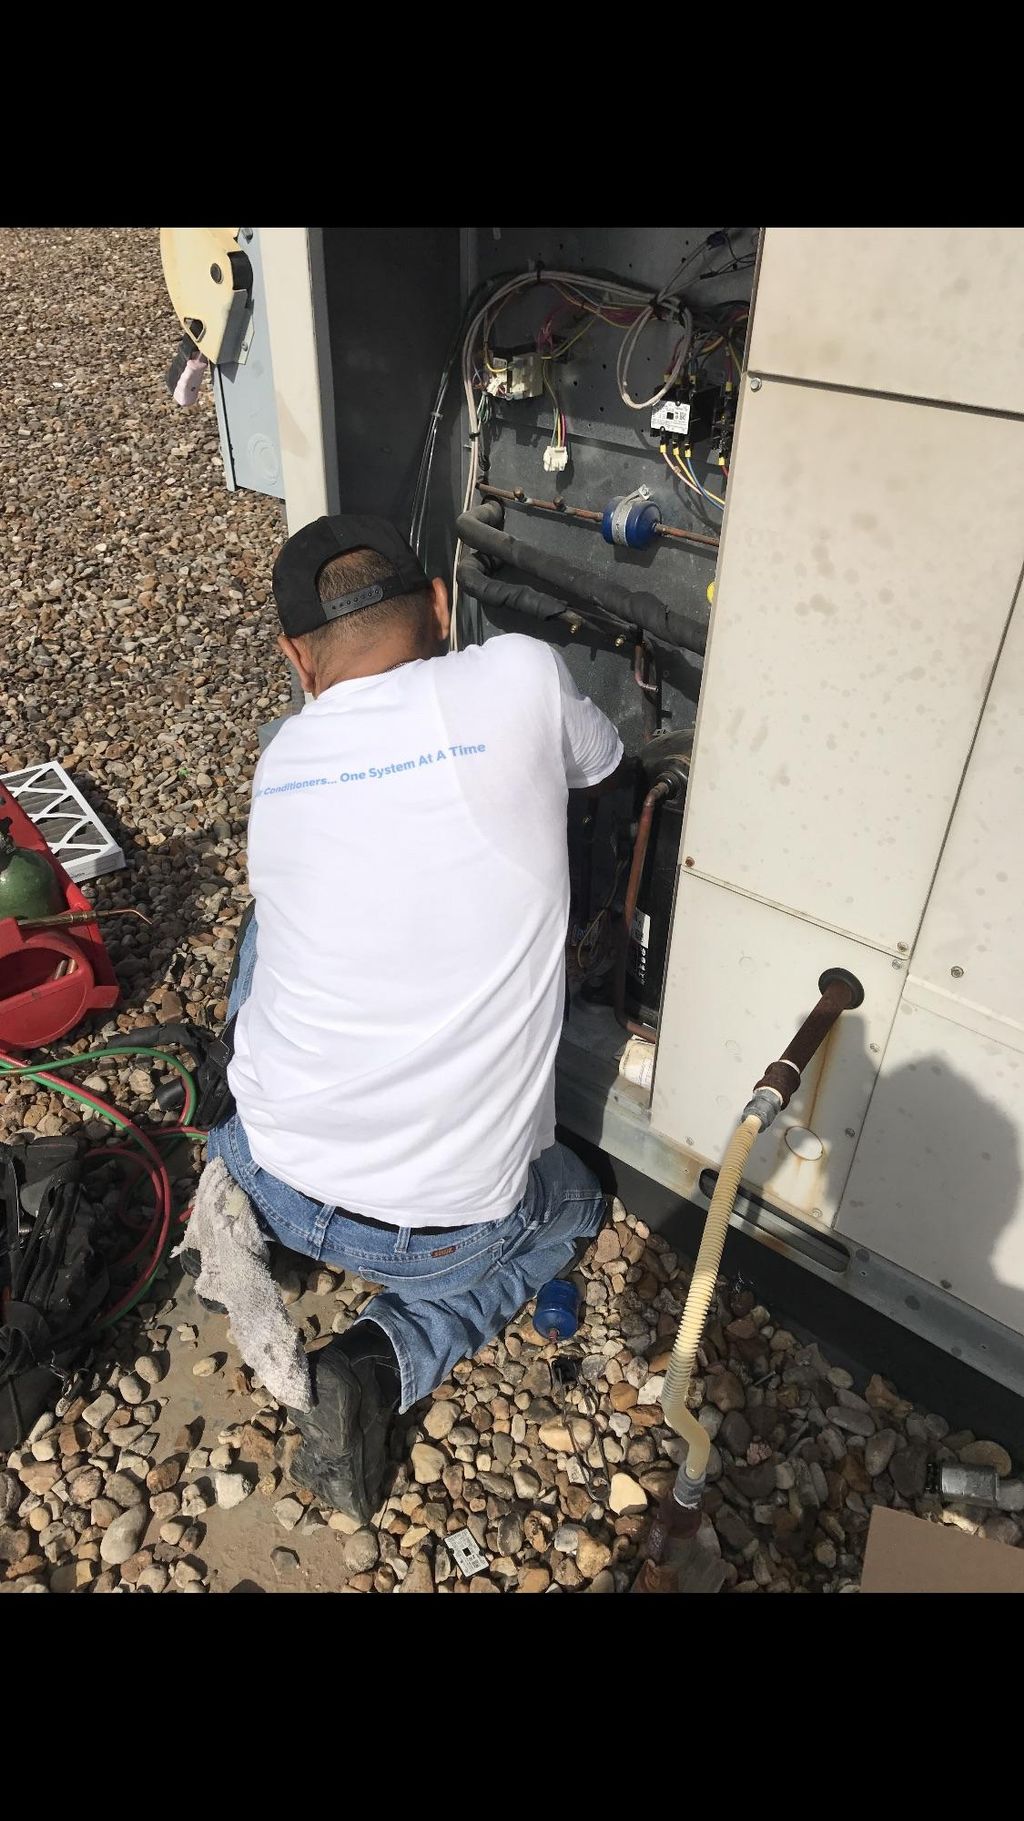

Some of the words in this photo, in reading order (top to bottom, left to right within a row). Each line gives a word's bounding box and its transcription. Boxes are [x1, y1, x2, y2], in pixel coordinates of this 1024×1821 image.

[264, 777, 337, 796] Conditioners...
[340, 771, 366, 782] One
[369, 760, 416, 778] System
[419, 753, 433, 767] At
[436, 749, 446, 761] A
[449, 744, 486, 757] Time
